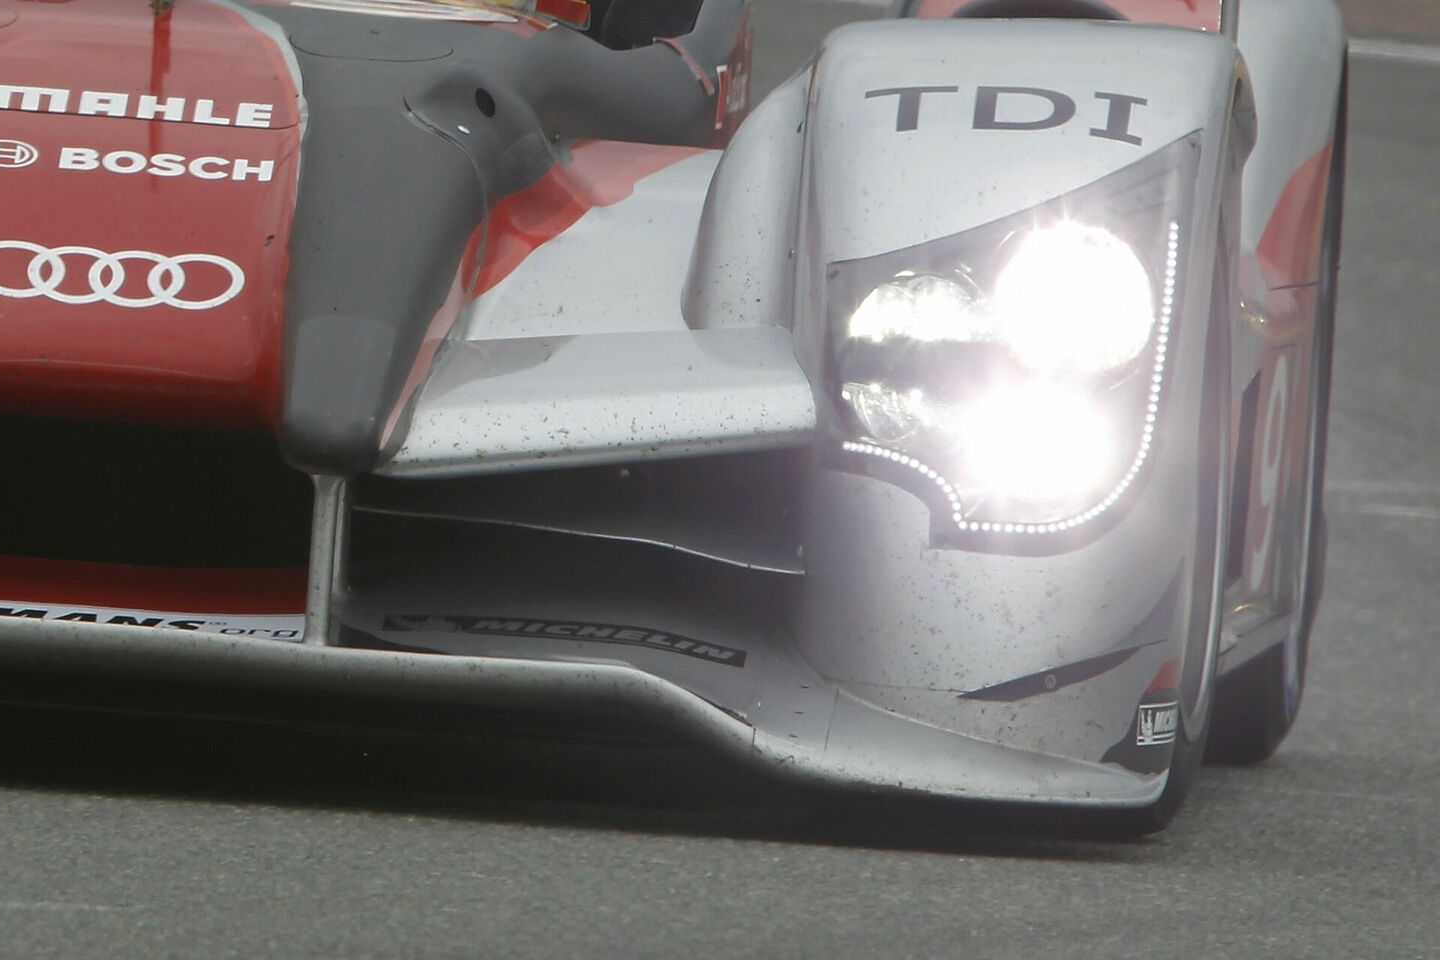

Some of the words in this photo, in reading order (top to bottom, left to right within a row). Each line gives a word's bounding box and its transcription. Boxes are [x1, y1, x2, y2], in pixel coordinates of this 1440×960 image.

[864, 86, 1148, 146] TDI
[59, 147, 275, 182] BOSCH
[472, 619, 735, 660] MICHELIN
